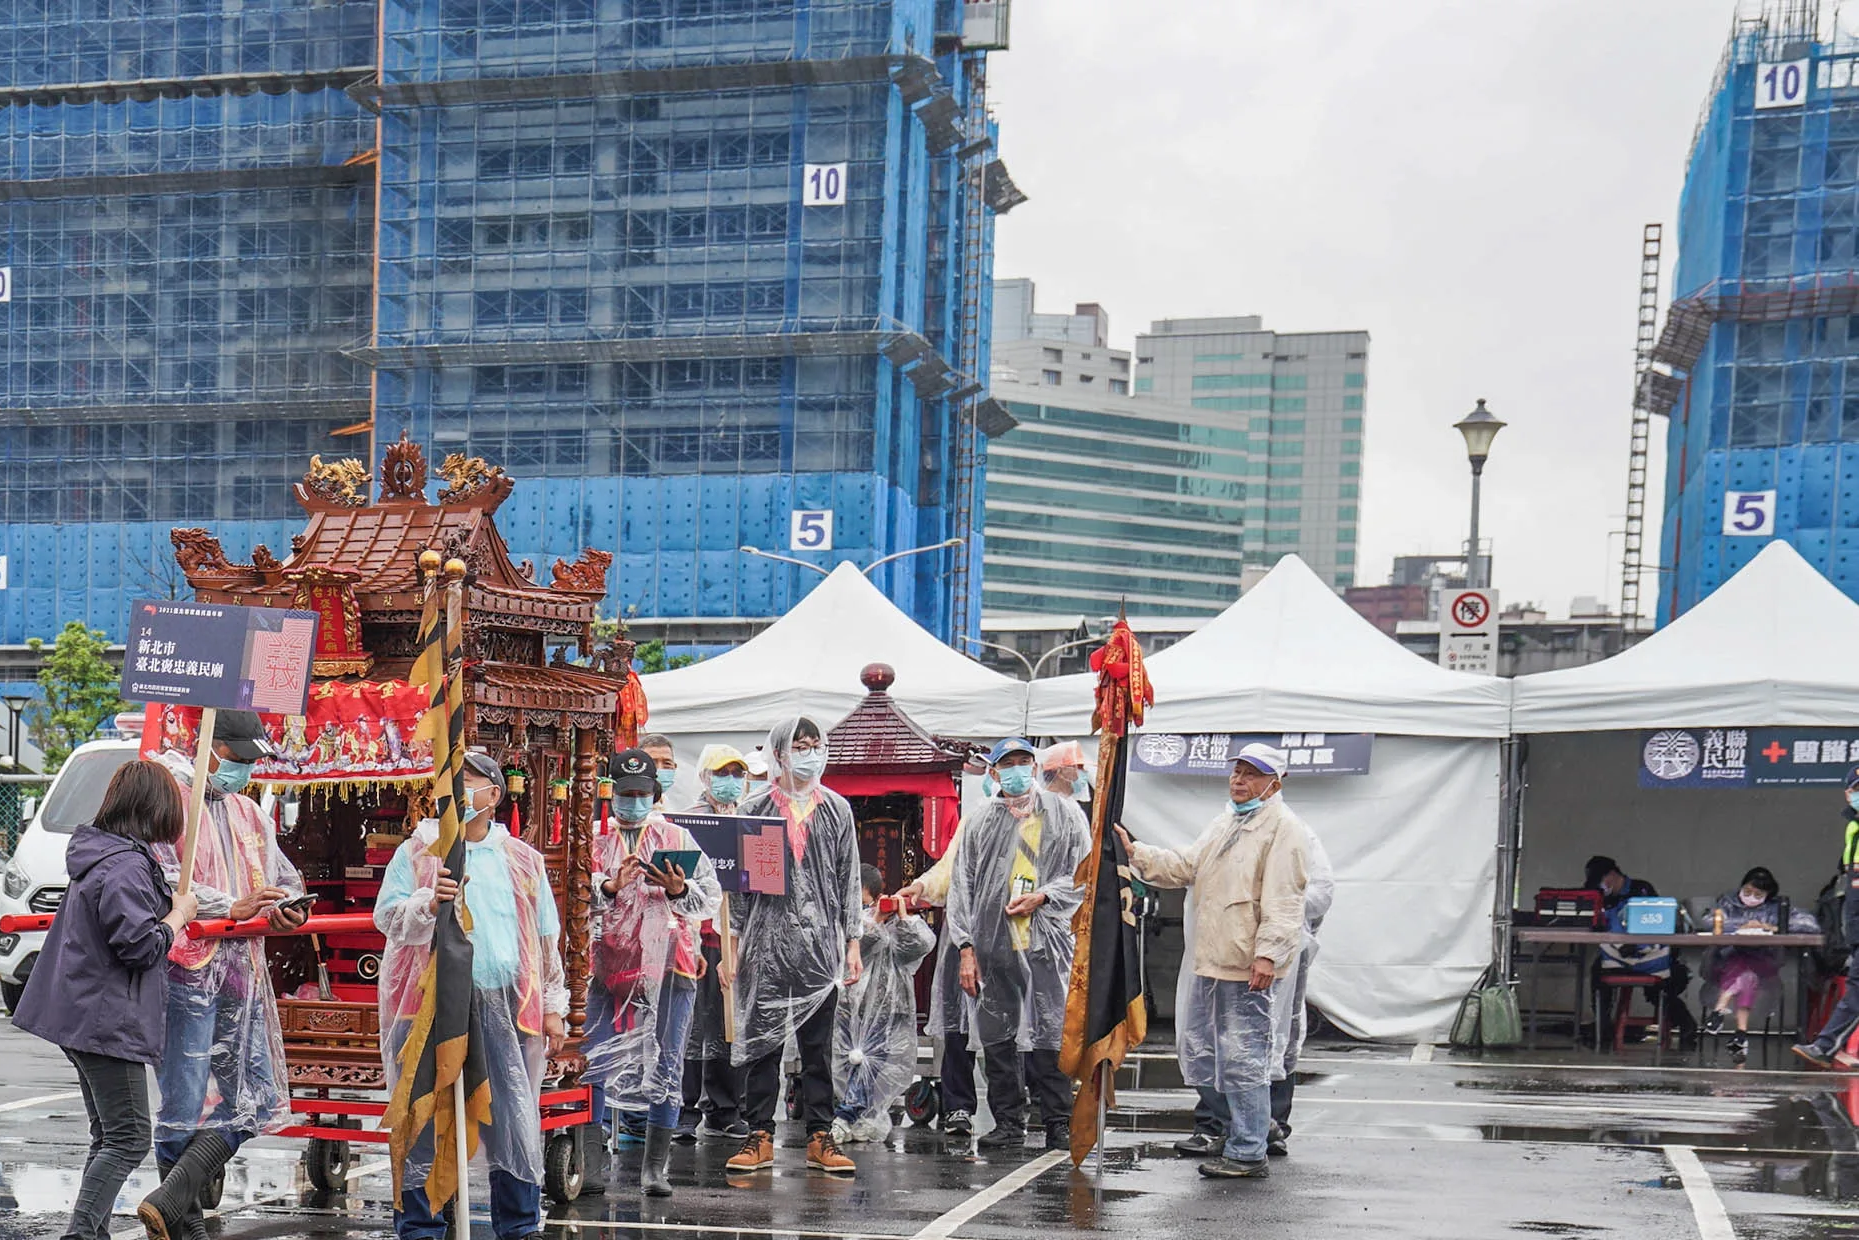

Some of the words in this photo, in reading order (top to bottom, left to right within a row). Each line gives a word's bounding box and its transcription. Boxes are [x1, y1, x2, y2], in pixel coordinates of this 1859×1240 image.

[1763, 64, 1800, 101] 10
[810, 168, 840, 200] 10
[1733, 495, 1766, 531] 5
[797, 513, 825, 548] 5
[1461, 600, 1481, 620] 停
[141, 627, 152, 637] 14
[137, 638, 177, 657] 新北市
[134, 656, 225, 679] 臺北褒忠義民廟
